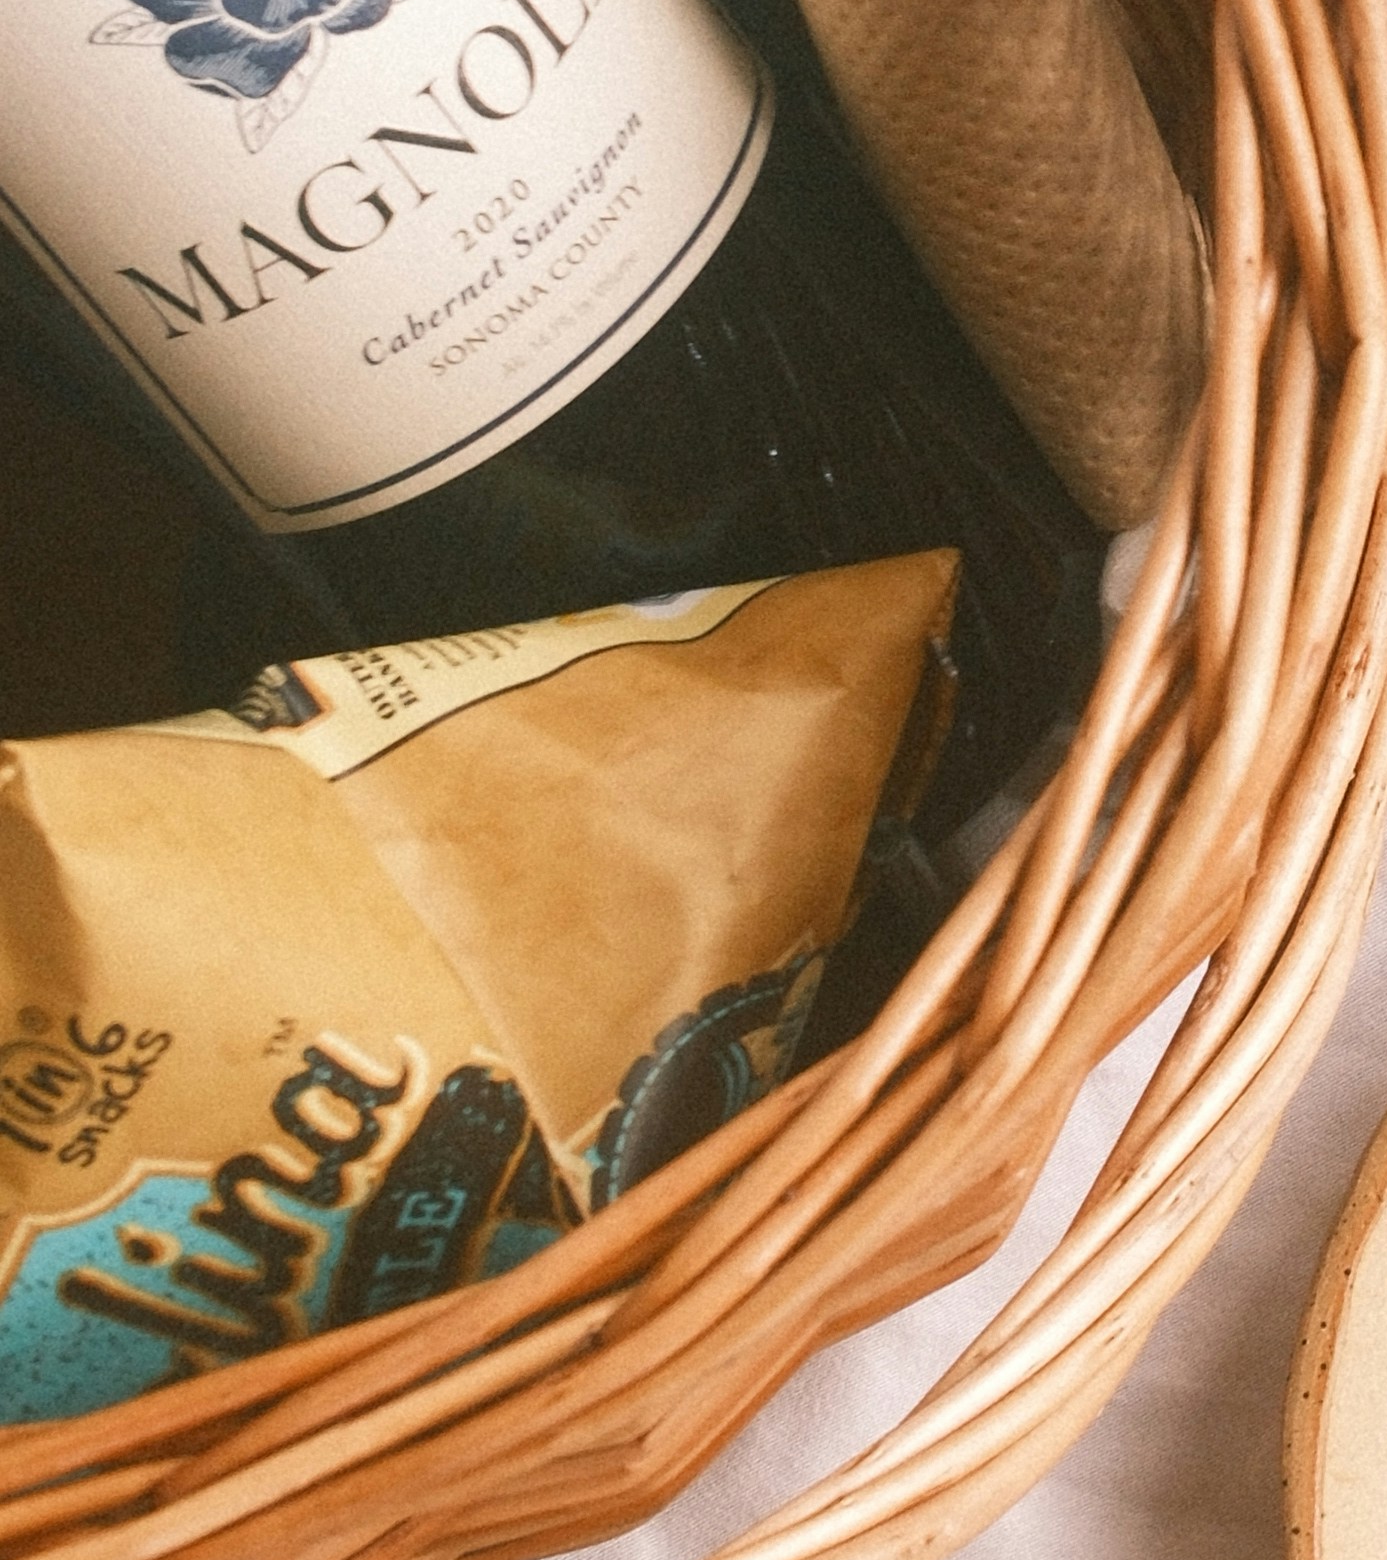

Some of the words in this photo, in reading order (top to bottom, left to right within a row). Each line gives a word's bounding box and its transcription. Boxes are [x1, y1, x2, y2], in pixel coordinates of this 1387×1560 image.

[362, 256, 506, 367] Cabernet
[511, 112, 643, 260] Sauvignon
[428, 283, 550, 377] SONOMA
[549, 174, 644, 282] COUNTY
[452, 178, 531, 255] 2020
[58, 1029, 173, 1169] snacks
